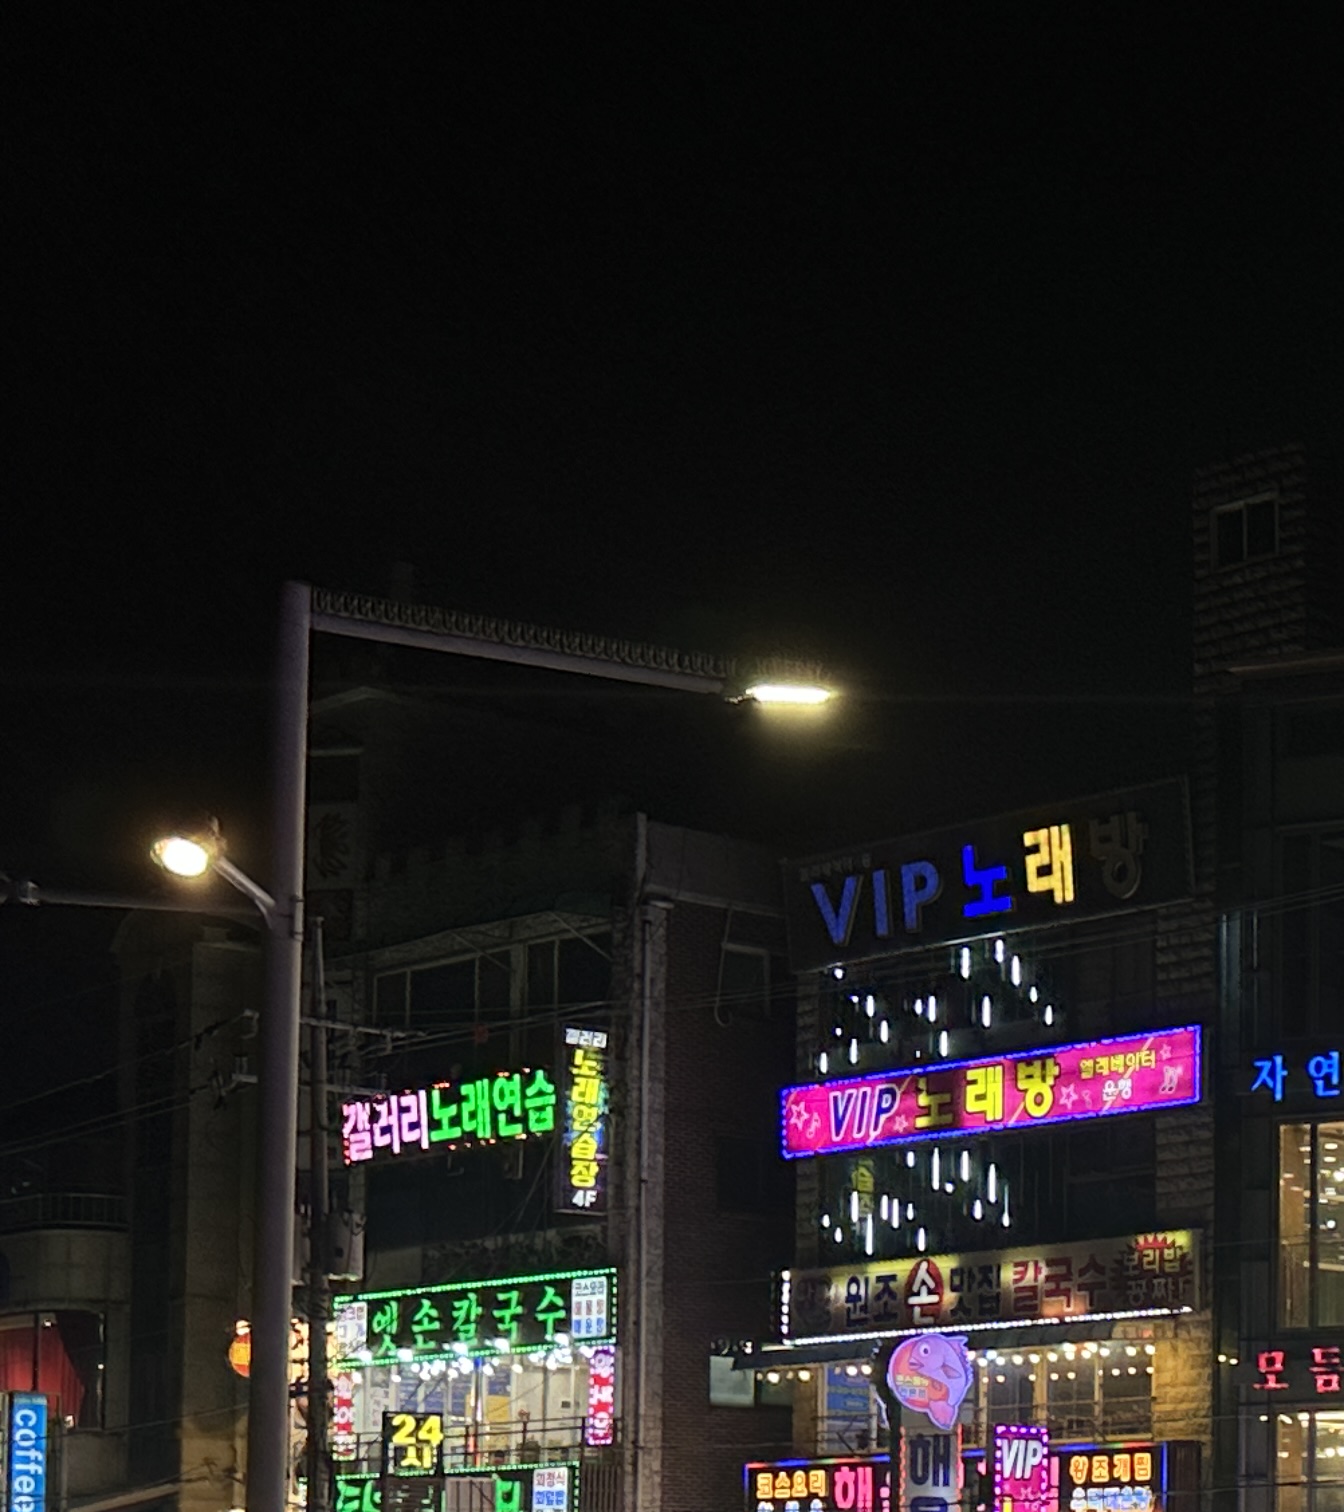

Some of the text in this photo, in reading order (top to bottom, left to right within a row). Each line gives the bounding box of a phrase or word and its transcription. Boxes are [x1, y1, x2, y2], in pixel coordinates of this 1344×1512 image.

[811, 811, 1149, 946] VIP 노래방
[829, 1058, 1060, 1142] VIP 노래방
[1102, 1078, 1133, 1102] 운행
[570, 1049, 600, 1187] 노래연습장
[571, 1190, 598, 1207] 4F
[1123, 1249, 1184, 1284] 보리밥
[846, 1273, 898, 1323] 원조
[1012, 1254, 1110, 1312] 칼국수
[391, 1413, 444, 1445] 24
[400, 1444, 432, 1469] 시
[1001, 1438, 1044, 1479] VIP
[757, 1469, 827, 1500] 코스요리
